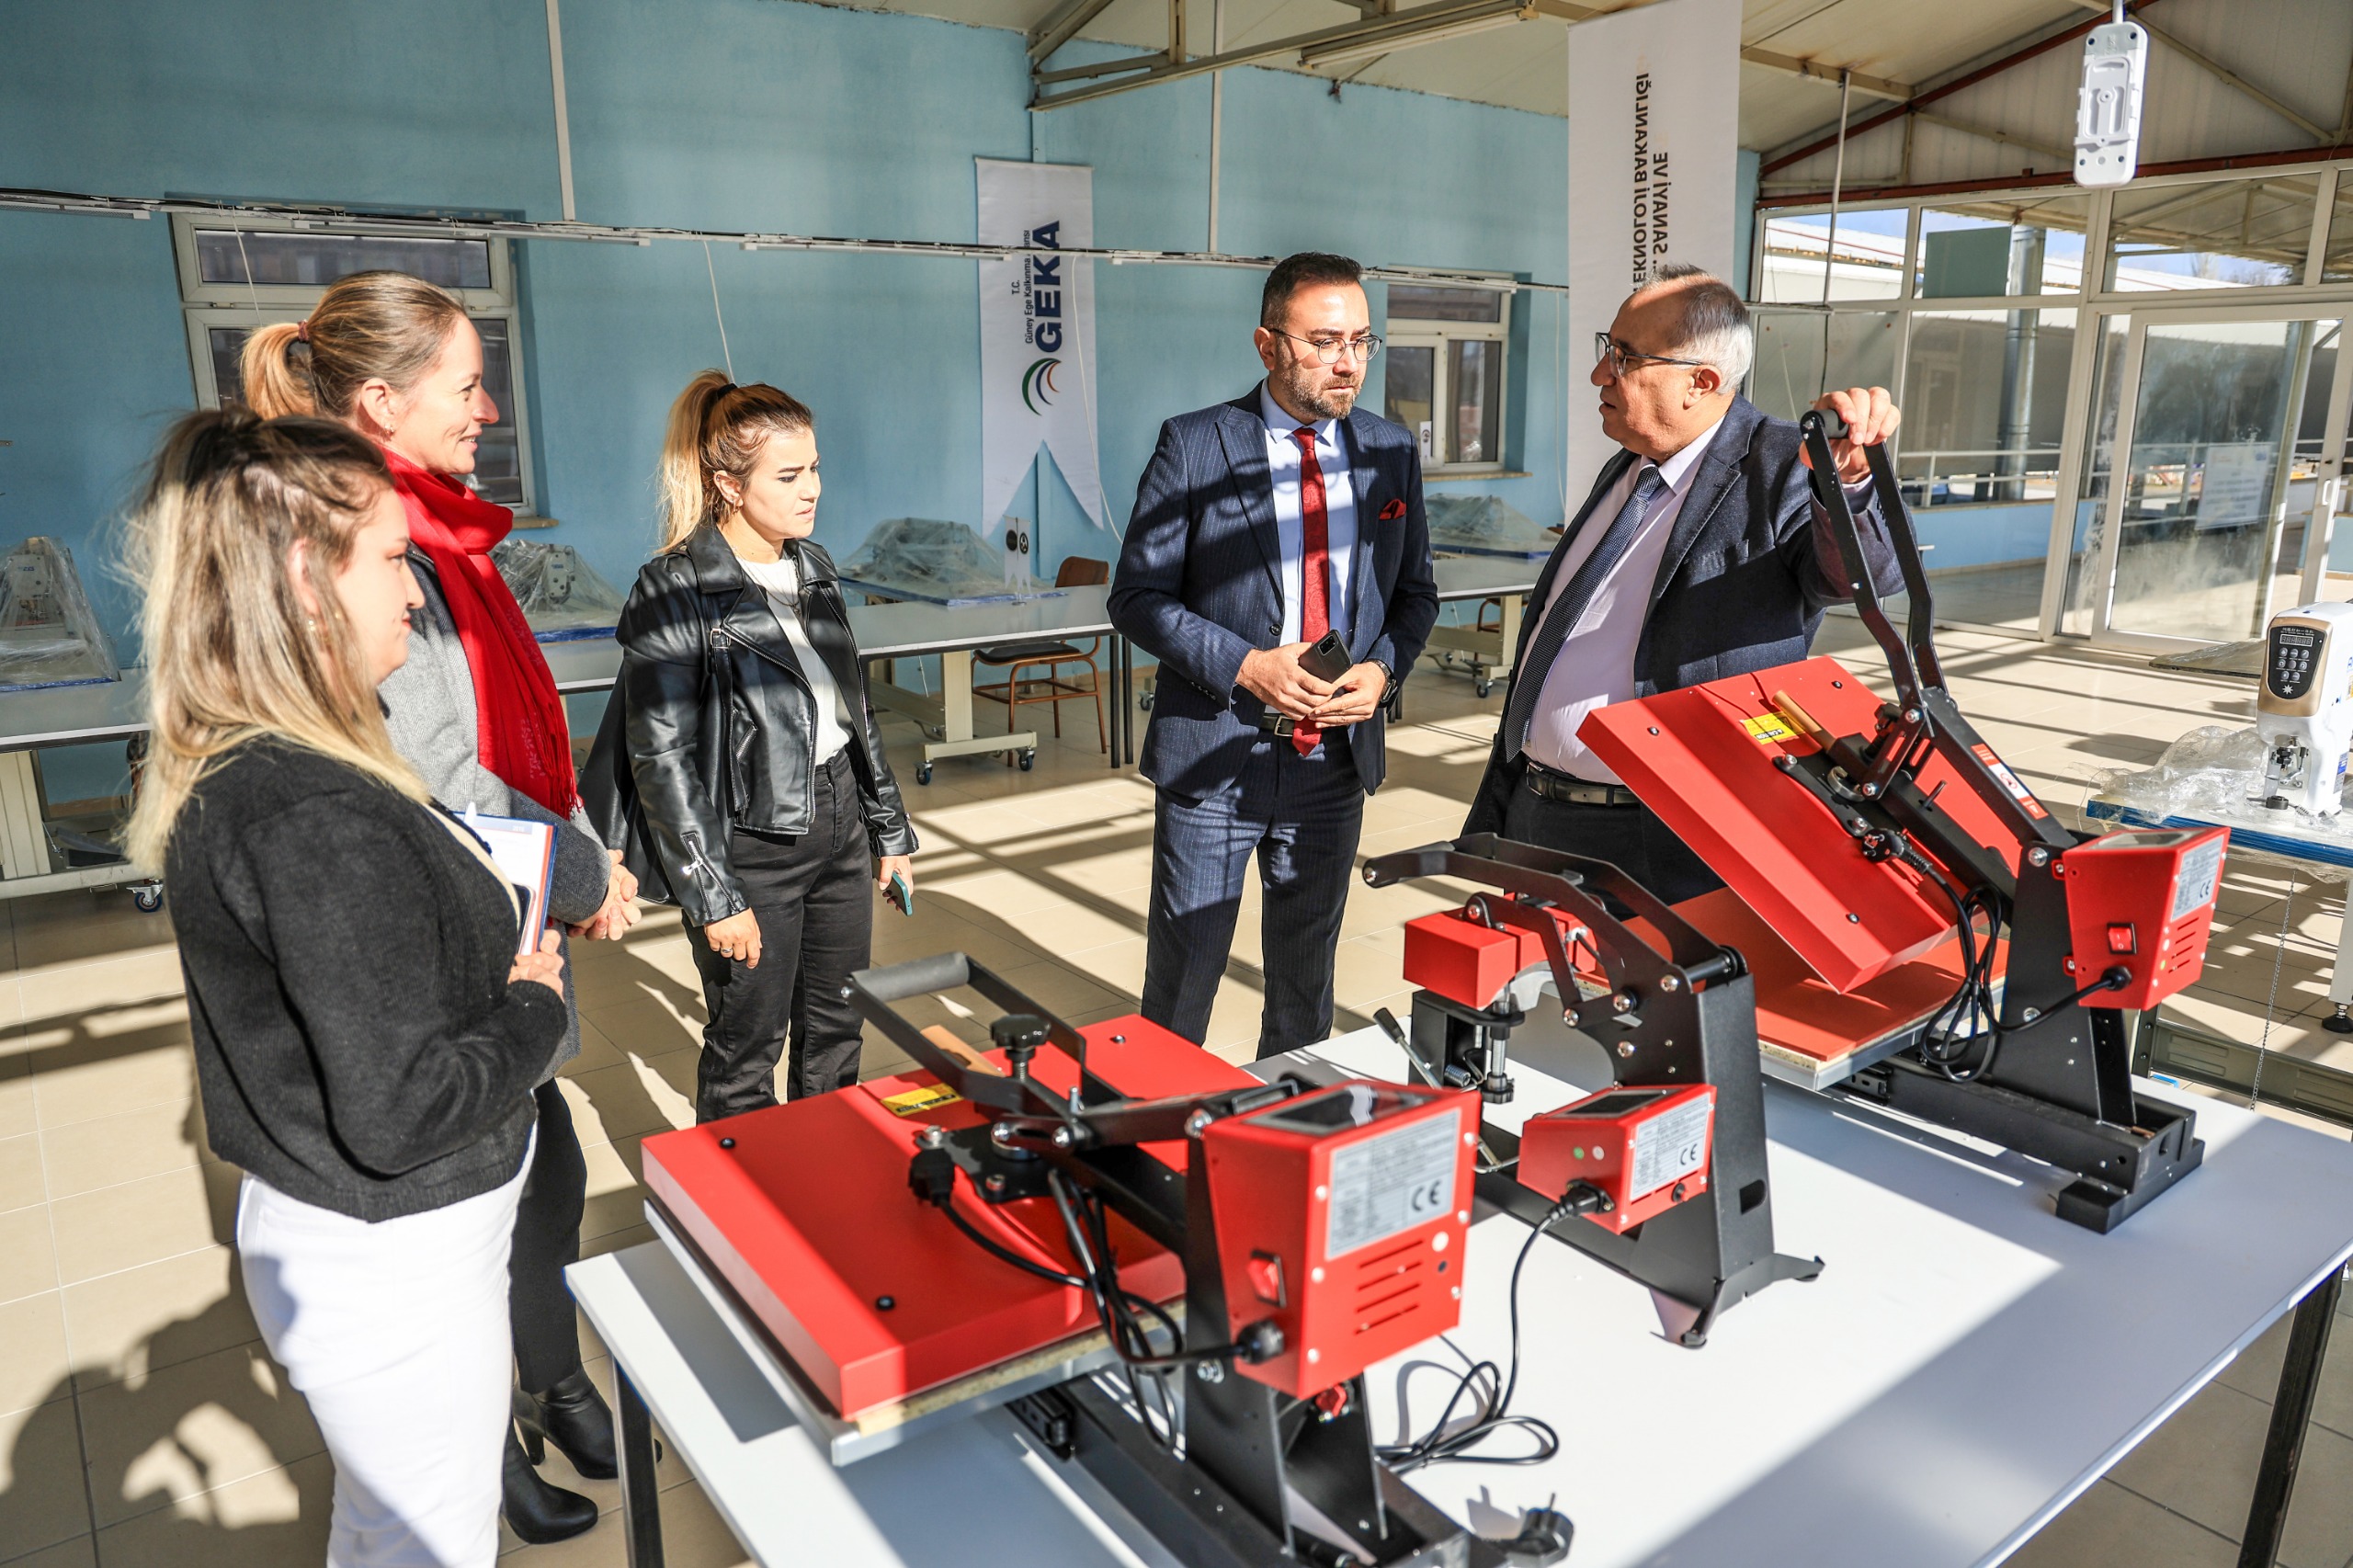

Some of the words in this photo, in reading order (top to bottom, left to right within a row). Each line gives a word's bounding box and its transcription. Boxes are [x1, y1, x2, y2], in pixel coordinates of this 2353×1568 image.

[1011, 279, 1019, 295] T.C.
[1024, 257, 1032, 298] Kalkınma
[1032, 221, 1063, 353] GEKA
[1024, 300, 1033, 315] Ege
[1025, 317, 1034, 345] Güney
[1679, 1142, 1698, 1166] CE
[1411, 1178, 1443, 1213] CE
